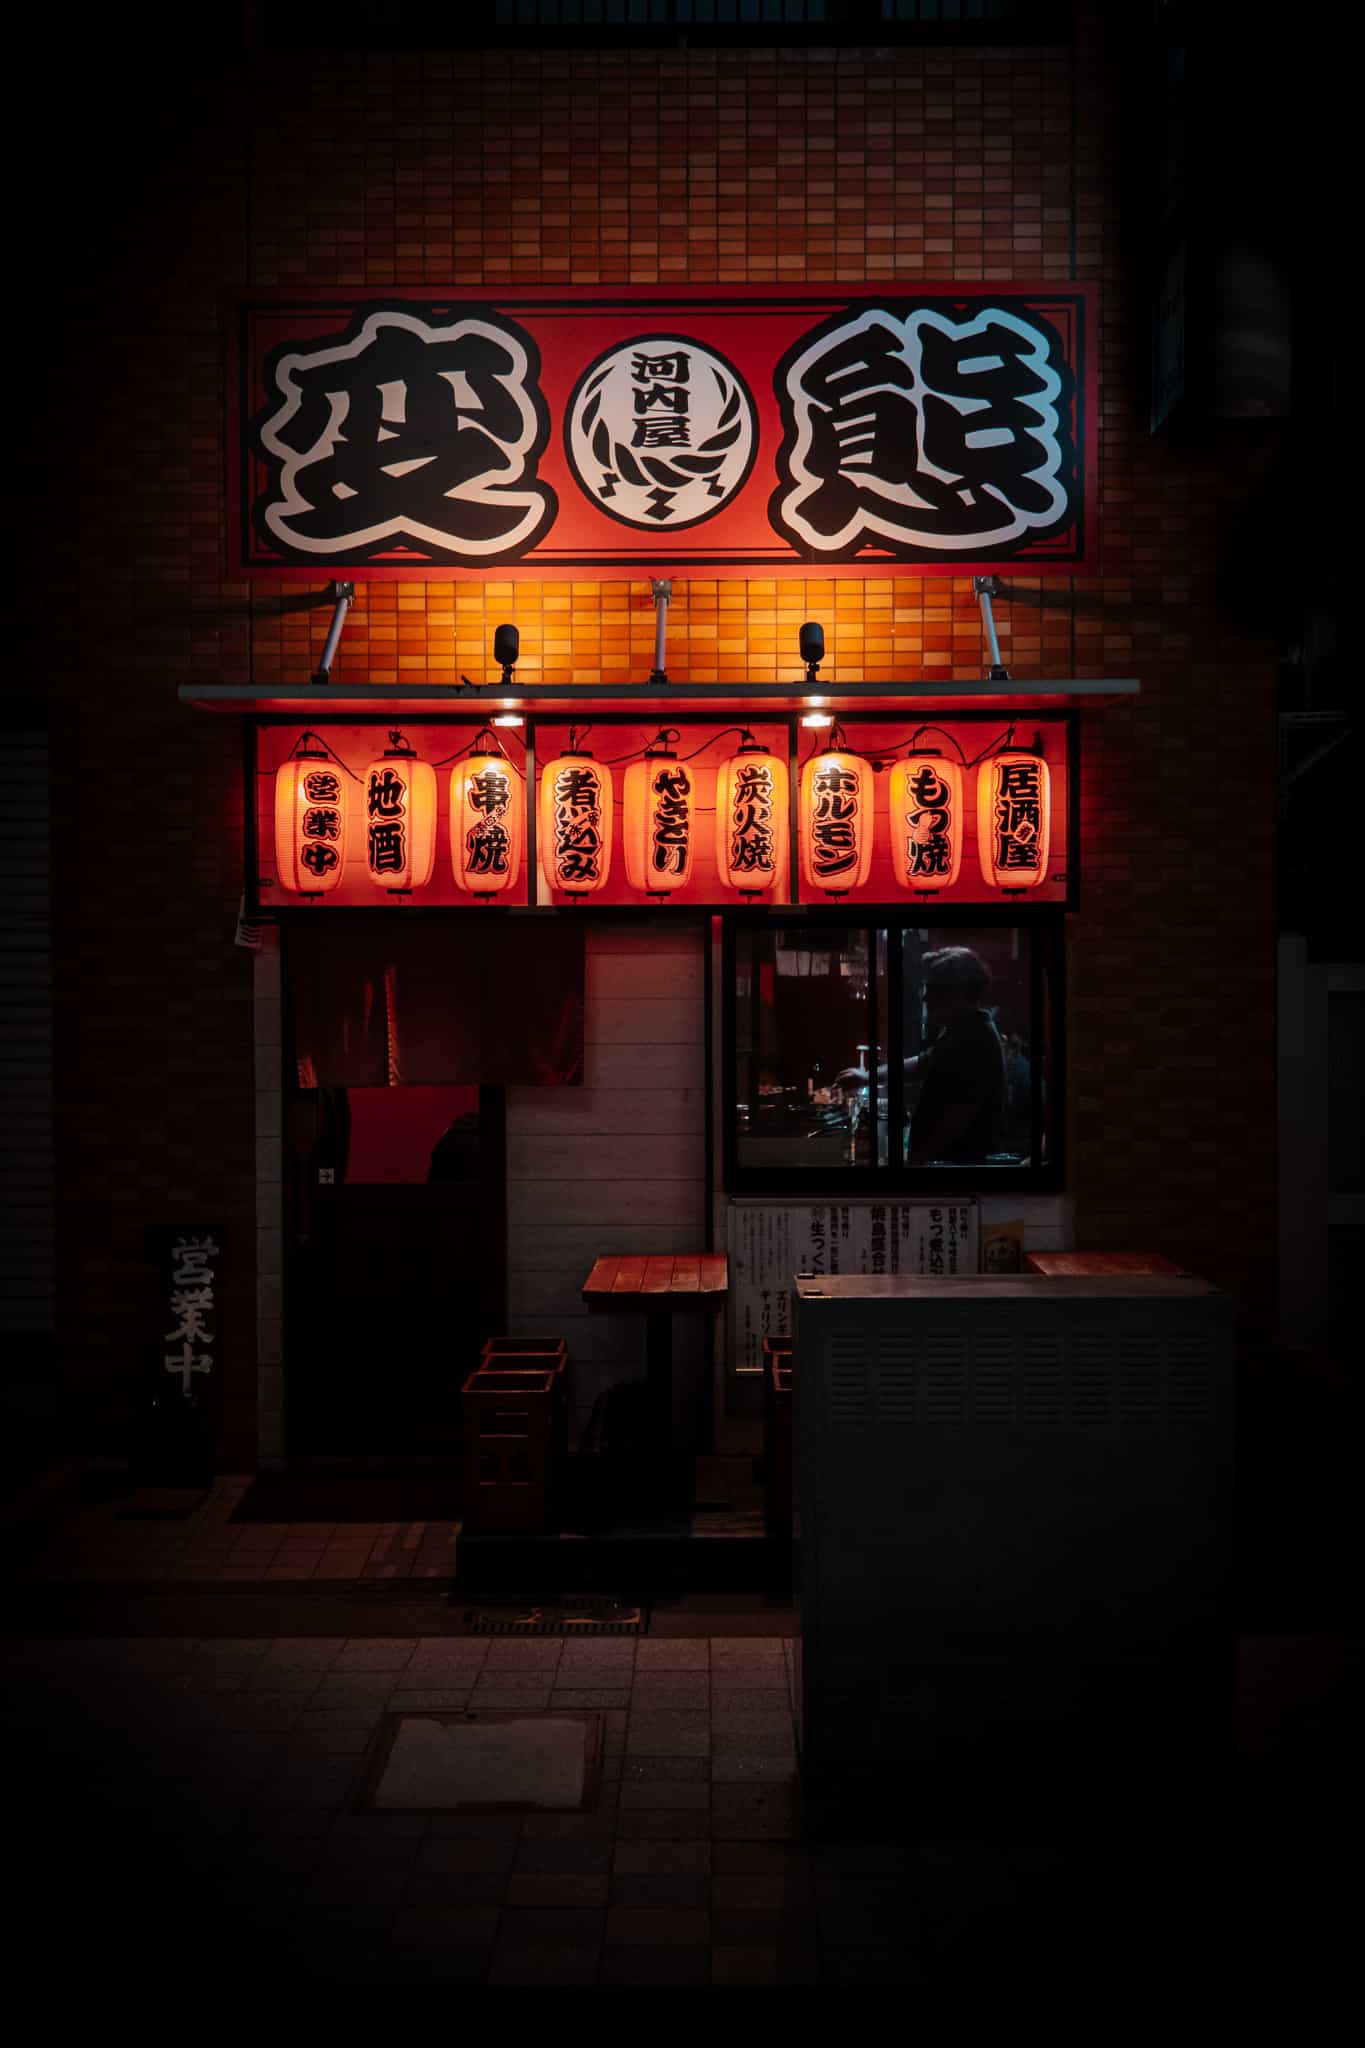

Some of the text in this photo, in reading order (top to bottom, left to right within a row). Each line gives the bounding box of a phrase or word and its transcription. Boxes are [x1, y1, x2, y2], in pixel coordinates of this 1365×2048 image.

[264, 314, 542, 552] 変
[631, 351, 692, 448] 河内屋
[304, 771, 340, 876] 営業中
[367, 768, 407, 874] 地酒
[466, 769, 511, 874] 串焼
[555, 767, 600, 880] 煮込み
[653, 767, 690, 874] やきとり
[732, 763, 775, 872] 炭火焼
[811, 765, 858, 876] ホルモン
[906, 765, 951, 876] もつ焼
[995, 760, 1041, 870] 居酒屋
[164, 1233, 220, 1397] 営業中
